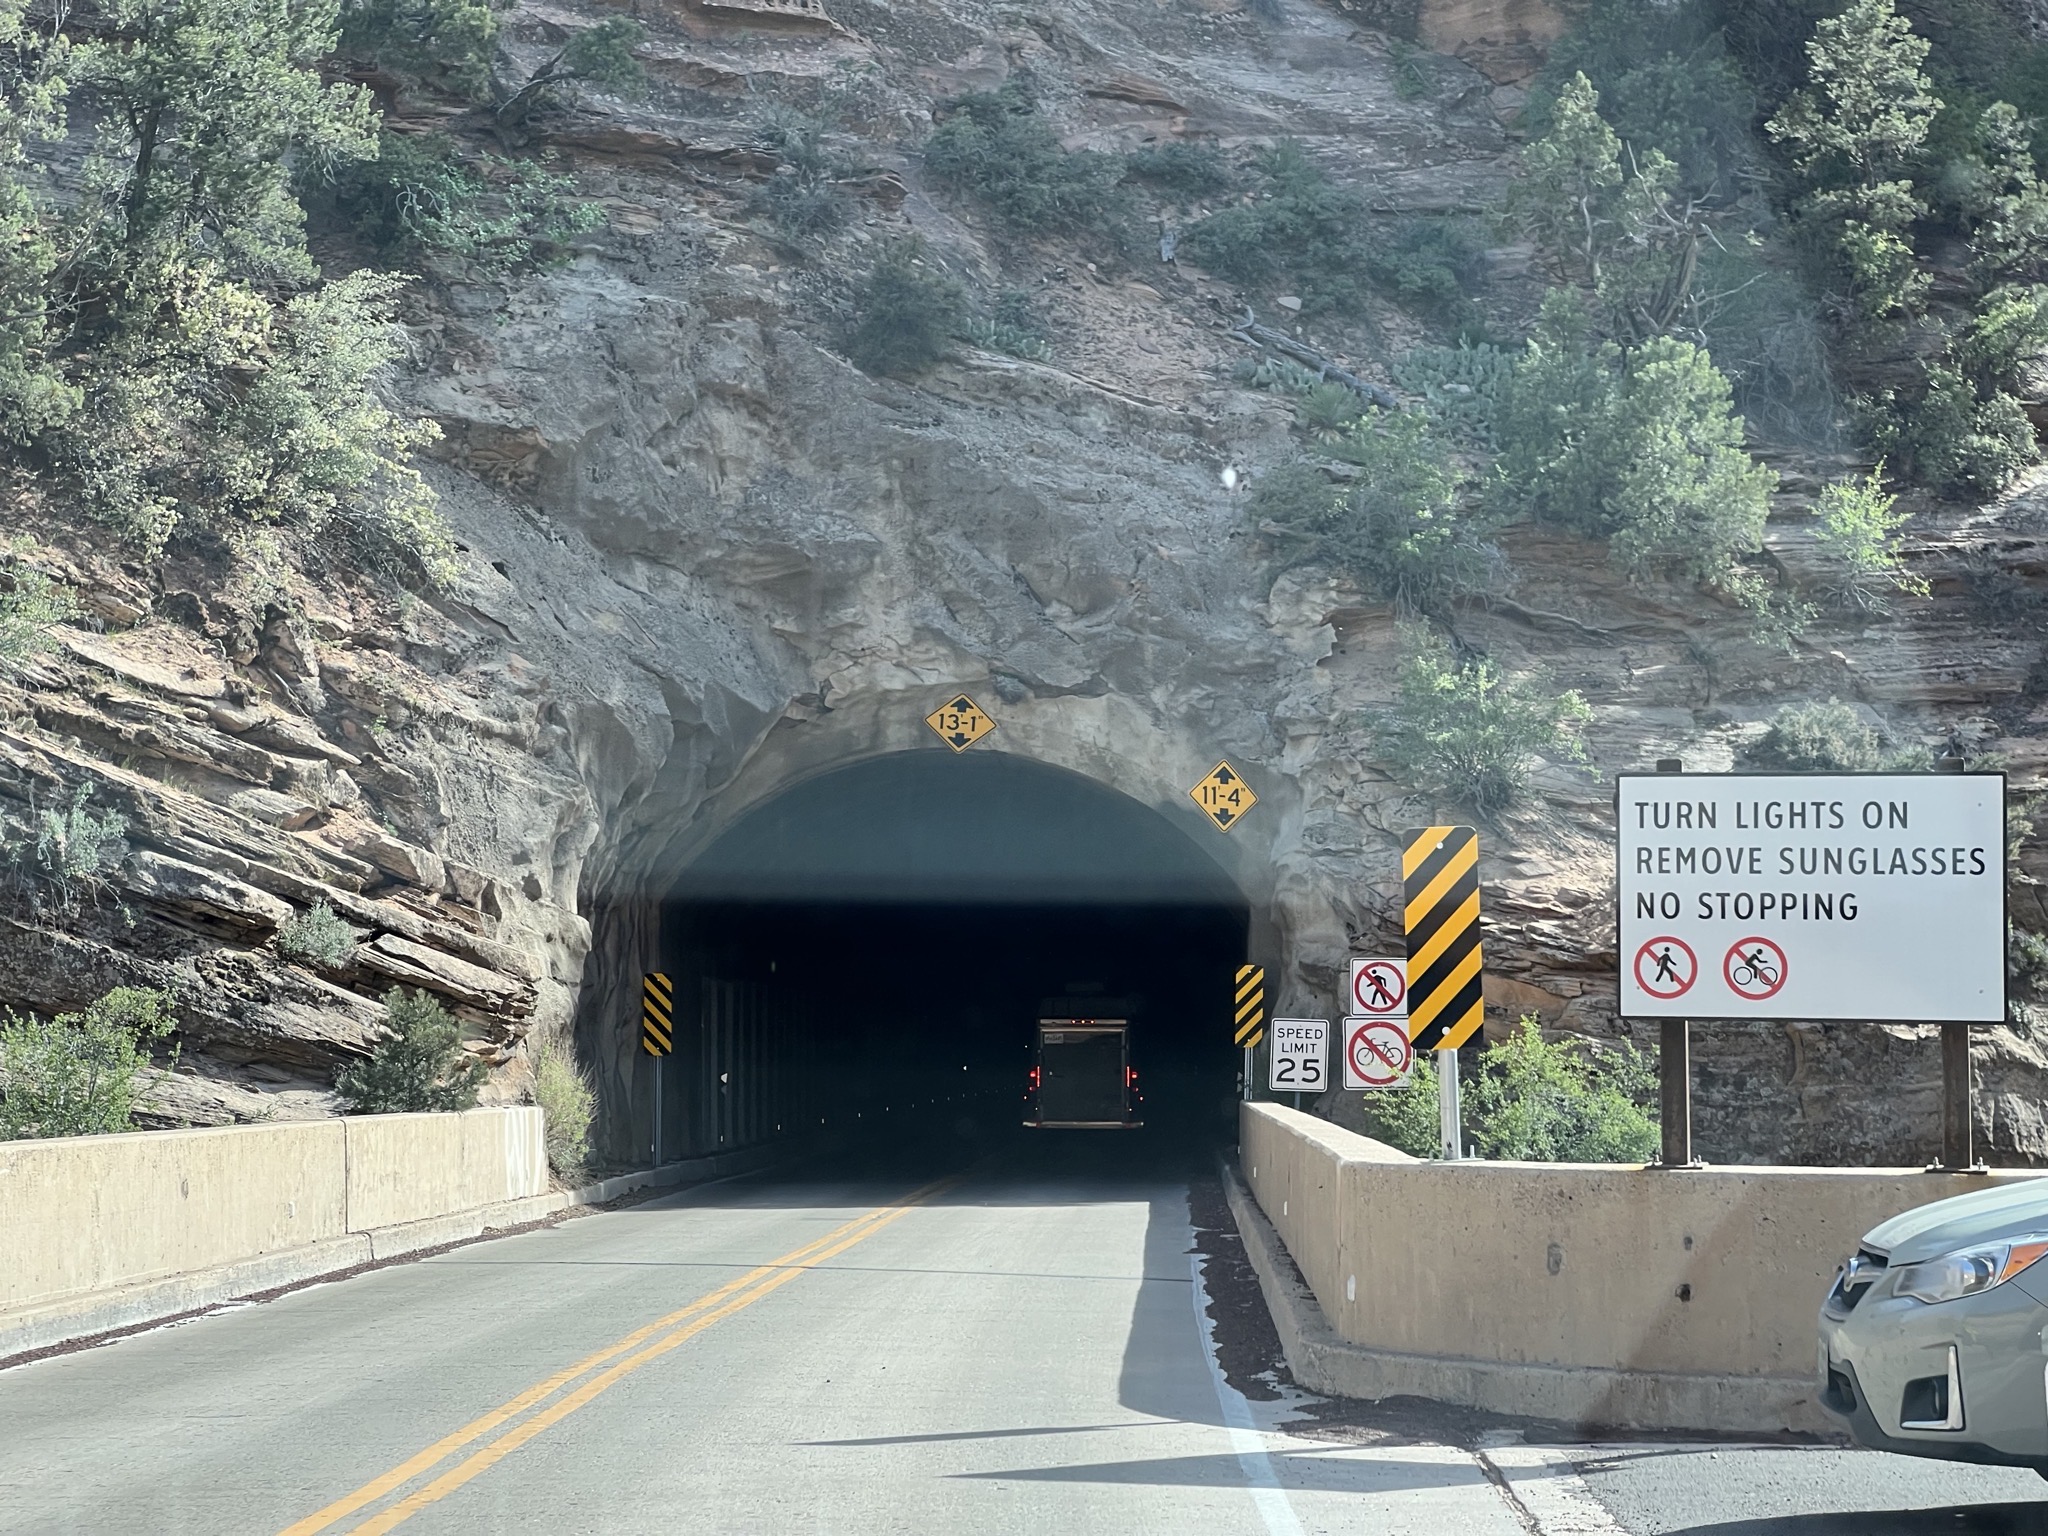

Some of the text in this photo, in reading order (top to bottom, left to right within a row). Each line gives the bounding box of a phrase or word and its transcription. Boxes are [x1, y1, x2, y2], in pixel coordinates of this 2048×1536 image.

[939, 713, 983, 732] 13'-1"
[1203, 785, 1245, 807] 11'-4"
[1635, 801, 1909, 829] TURN LIGHTS ON
[1636, 846, 1986, 876] REMOVE SUNGLASSES
[1636, 892, 1859, 921] NO STOPPING
[1277, 1028, 1323, 1039] SPEED
[1281, 1042, 1317, 1053] LIMIT
[1276, 1058, 1321, 1083] 25
